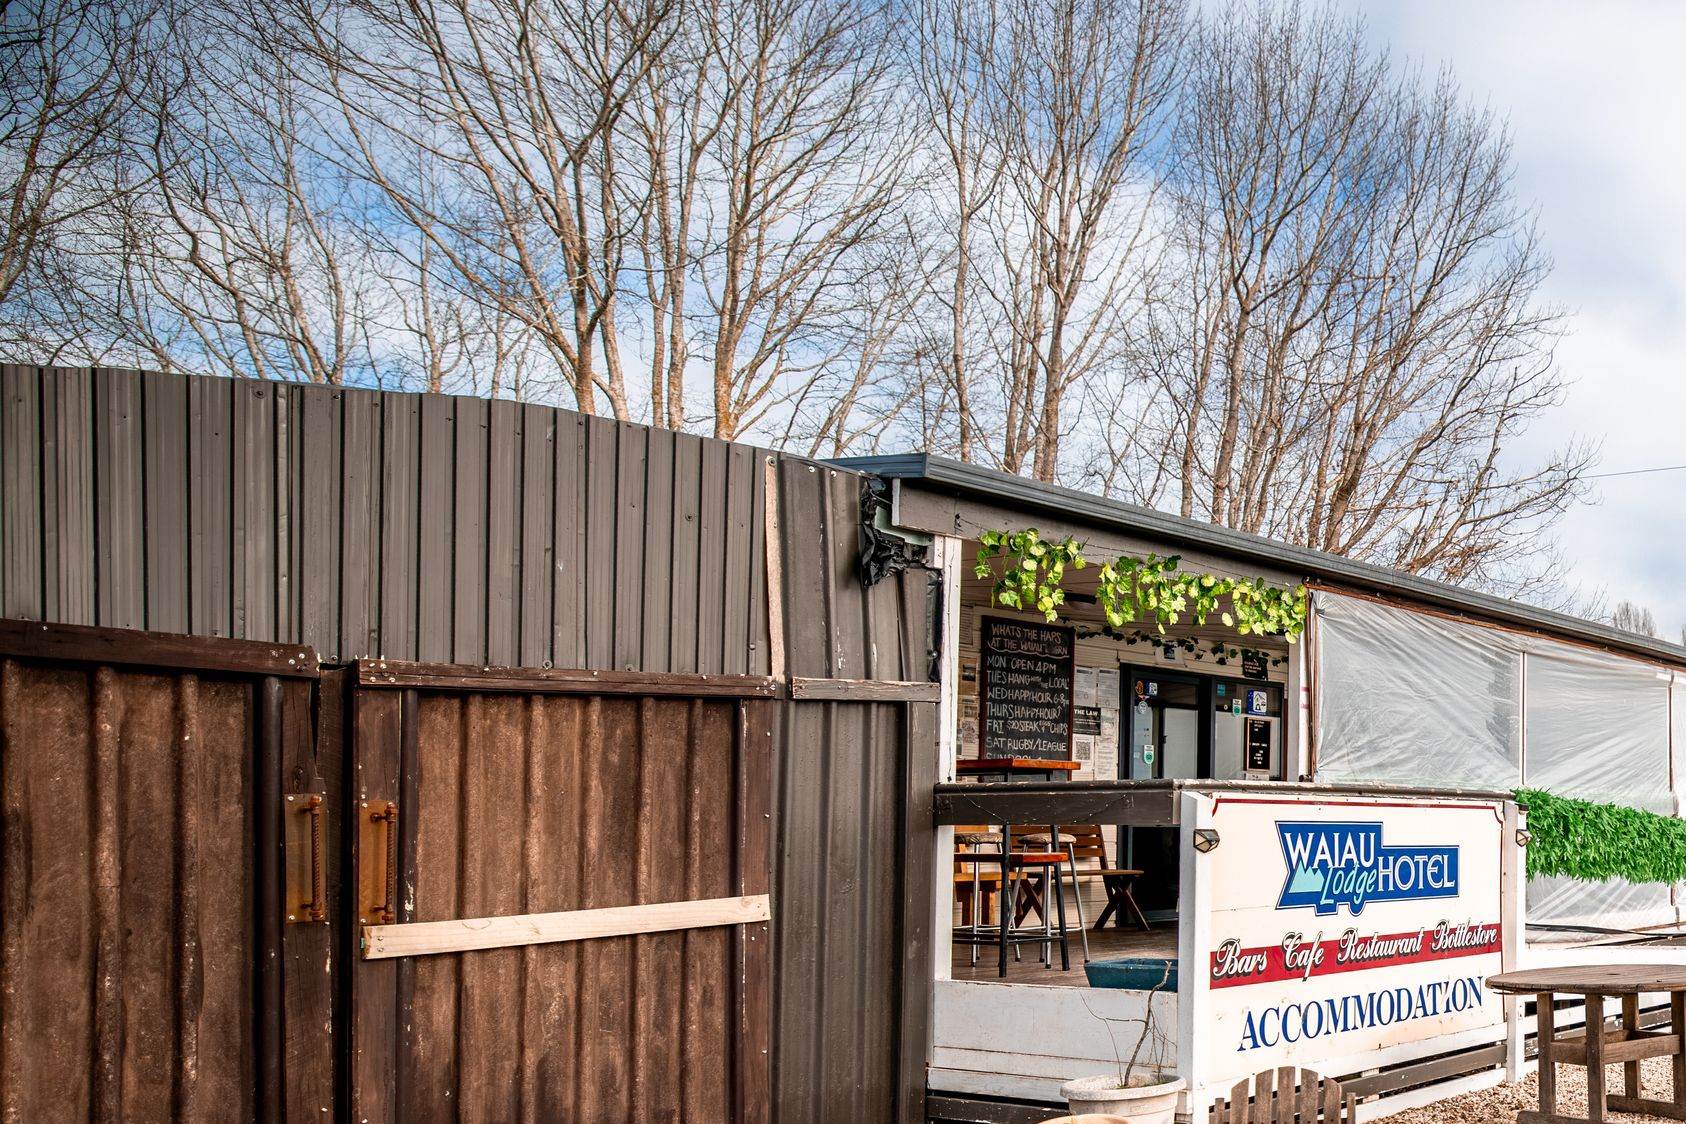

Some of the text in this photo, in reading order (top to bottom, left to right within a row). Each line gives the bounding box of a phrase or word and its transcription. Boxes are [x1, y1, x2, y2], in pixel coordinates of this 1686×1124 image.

[991, 623, 1061, 644] WHATS THE HAPS
[991, 637, 1001, 647] AT
[1004, 638, 1017, 649] THE
[987, 655, 1056, 674] MON OPEN 4PM
[987, 670, 1007, 684] TUES
[1008, 672, 1030, 686] HANG
[987, 686, 1008, 700] WED
[986, 702, 1014, 719] THURS
[1074, 708, 1085, 716] THE
[986, 719, 1005, 734] FRI
[1019, 721, 1041, 733] STEAK
[1049, 722, 1068, 736] CHIPS
[986, 736, 1007, 749] SAT
[1284, 832, 1377, 869] WAIAU
[1377, 854, 1456, 892] HOTEL
[1319, 860, 1377, 905] Lodge
[1213, 917, 1498, 981] Bars Cafe Restaurant Bottlestore
[1236, 975, 1484, 1053] ACCOMMODATION
